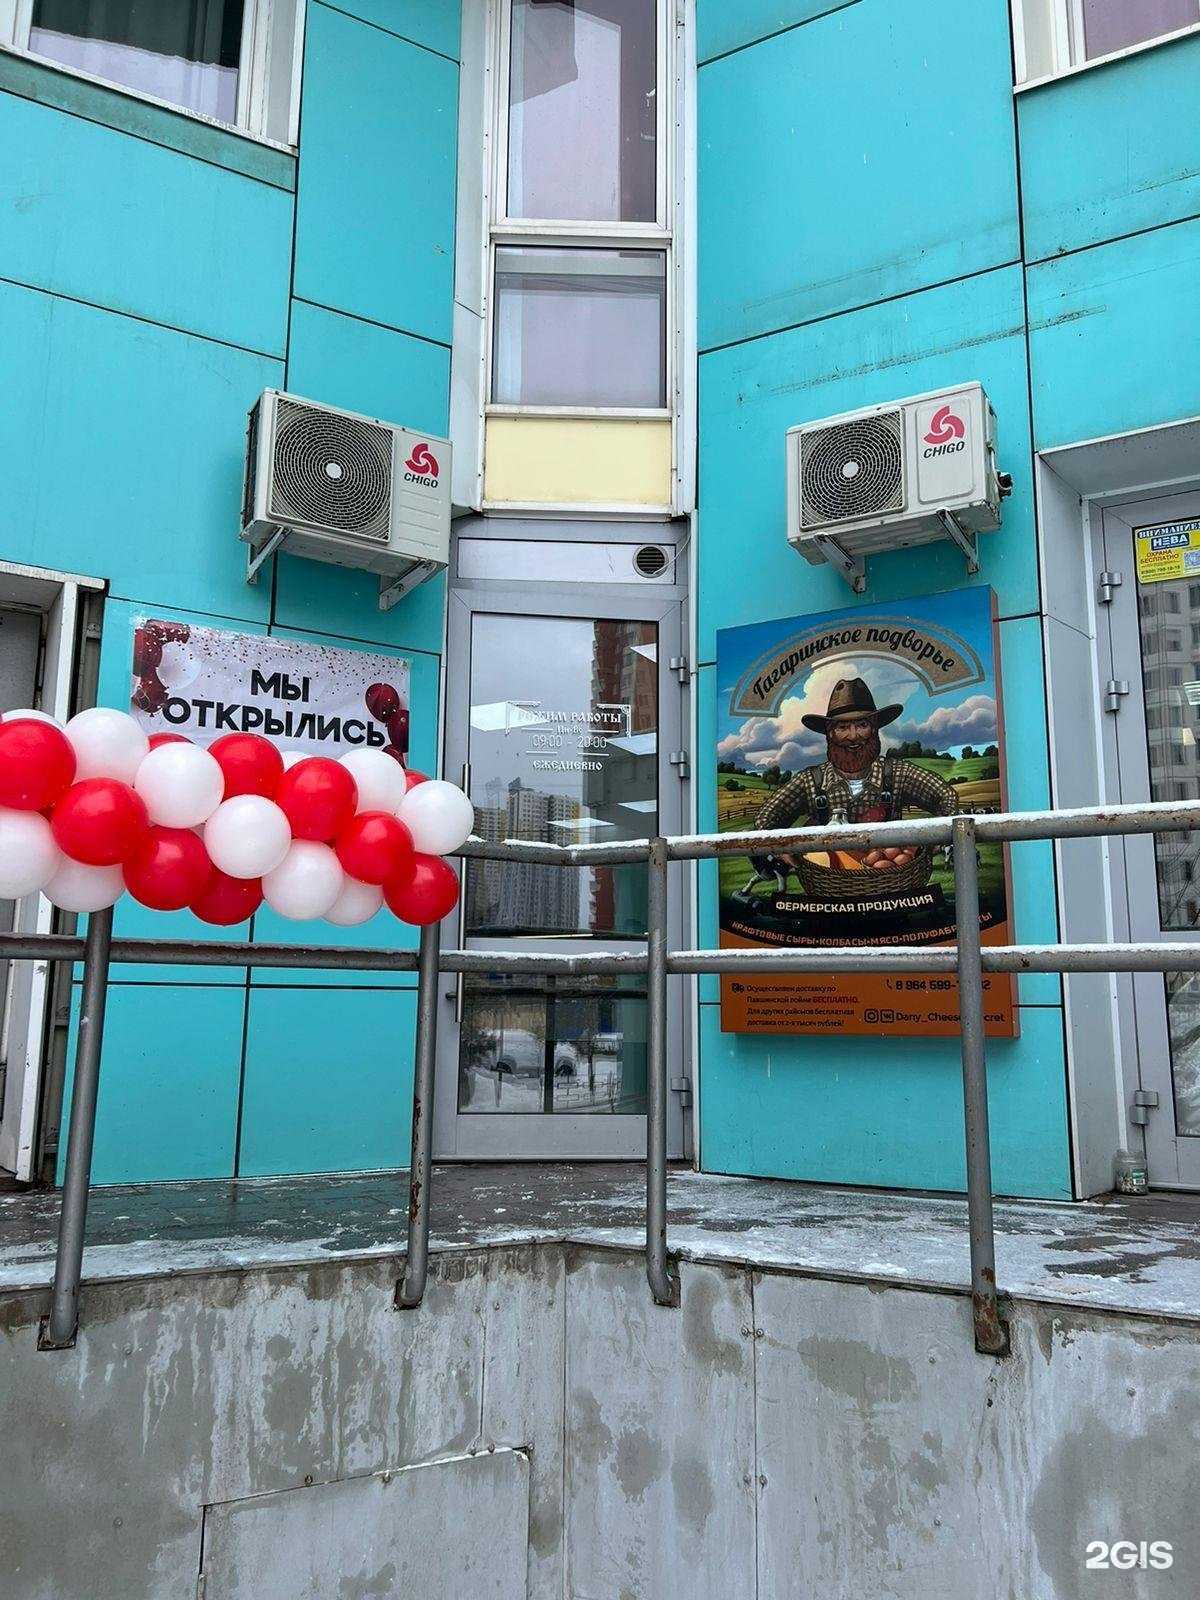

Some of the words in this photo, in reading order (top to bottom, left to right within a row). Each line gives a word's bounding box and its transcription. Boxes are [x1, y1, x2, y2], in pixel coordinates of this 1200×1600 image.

[923, 440, 965, 459] CHIGO
[403, 472, 439, 488] CHIGO
[753, 629, 862, 701] Гагаринское
[866, 626, 955, 672] подворье
[250, 669, 311, 702] МЫ
[161, 696, 386, 748] ОТКРЫЛИСЬ
[571, 711, 622, 723] РАБОТЫ
[577, 736, 608, 749] 20:00
[775, 901, 855, 912] ФЕРМЕРСКАЯ
[857, 894, 934, 912] ПРОДУКЦИЯ
[731, 921, 785, 941] КРАФТОВЫЕ
